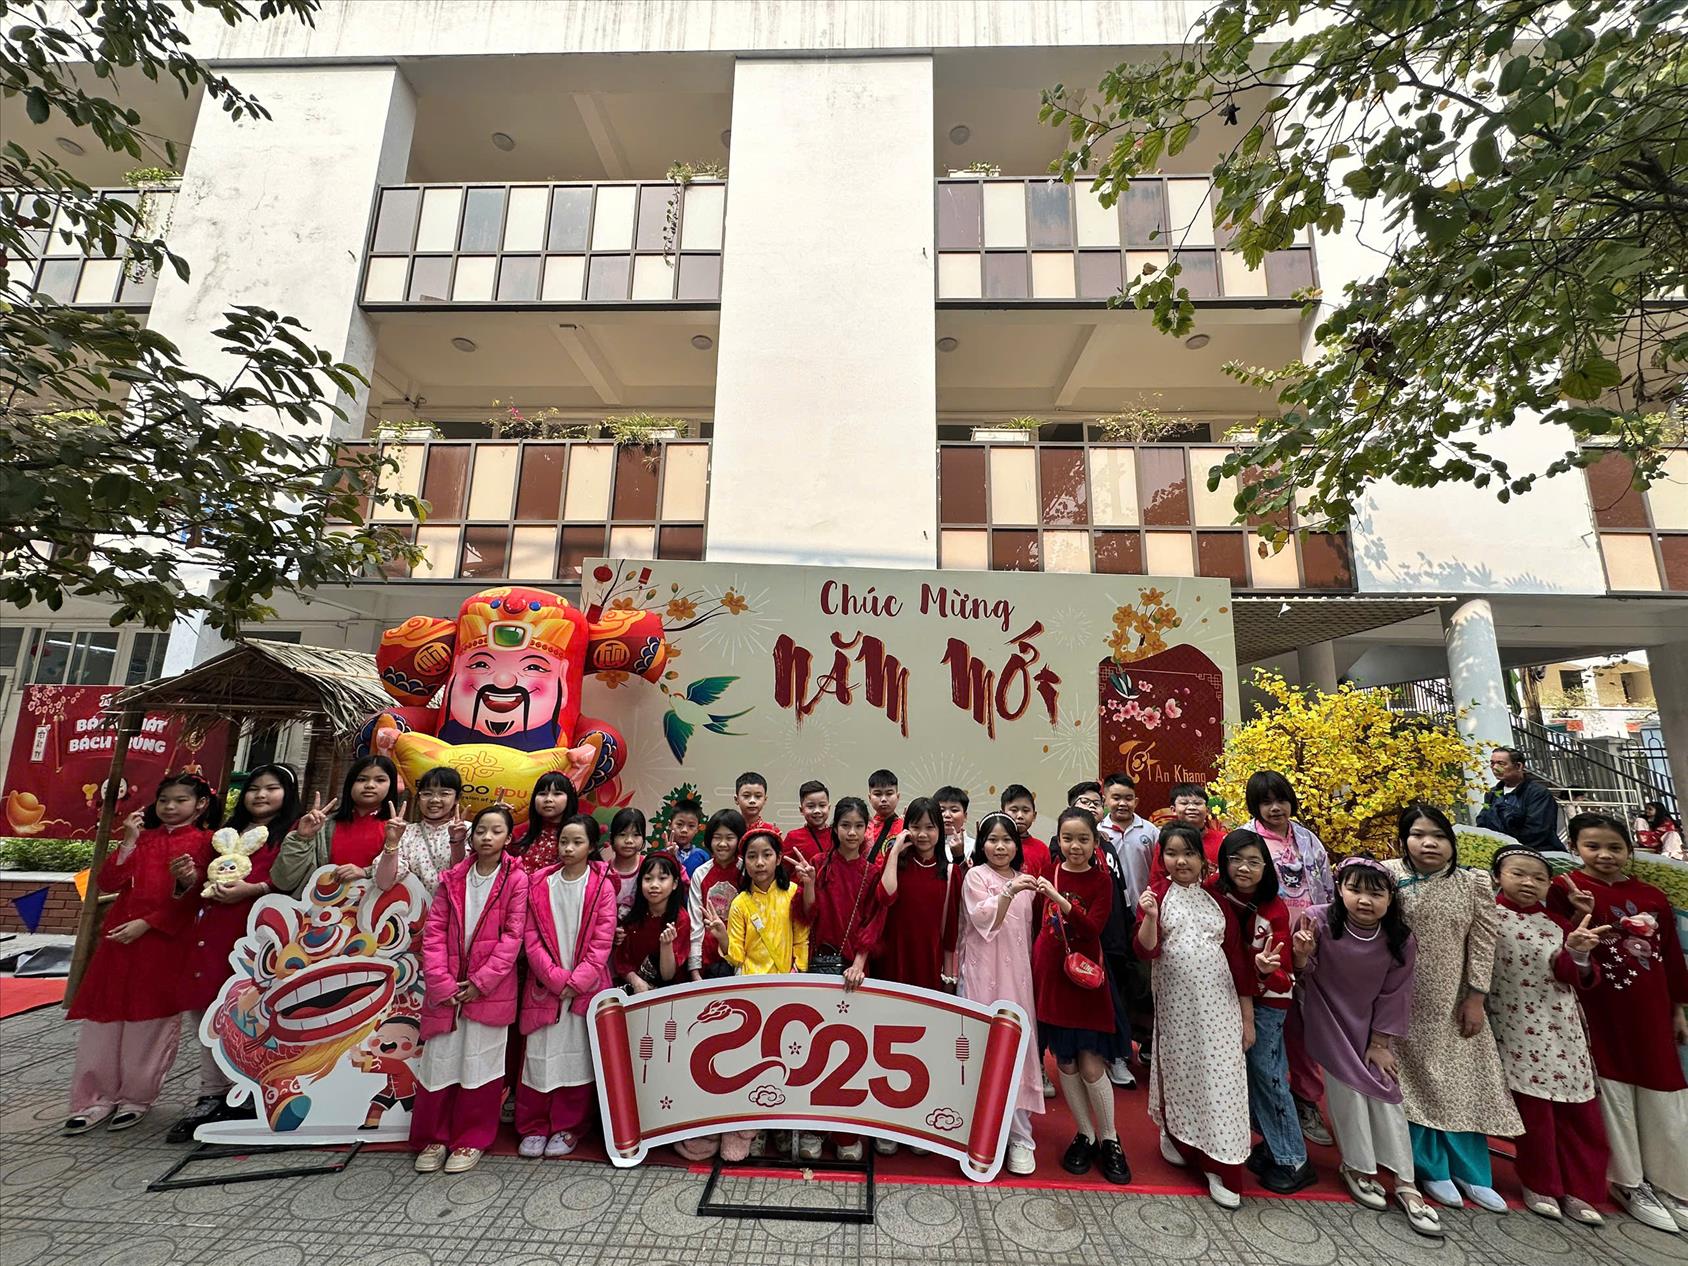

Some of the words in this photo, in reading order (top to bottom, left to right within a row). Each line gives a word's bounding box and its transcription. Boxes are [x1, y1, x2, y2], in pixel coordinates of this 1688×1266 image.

[820, 580, 903, 617] Chúc
[919, 583, 1015, 632] Mừng
[69, 735, 112, 752] BÁCH
[1155, 764, 1170, 783] An
[1174, 764, 1207, 787] Khang
[689, 998, 930, 1109] 2025
